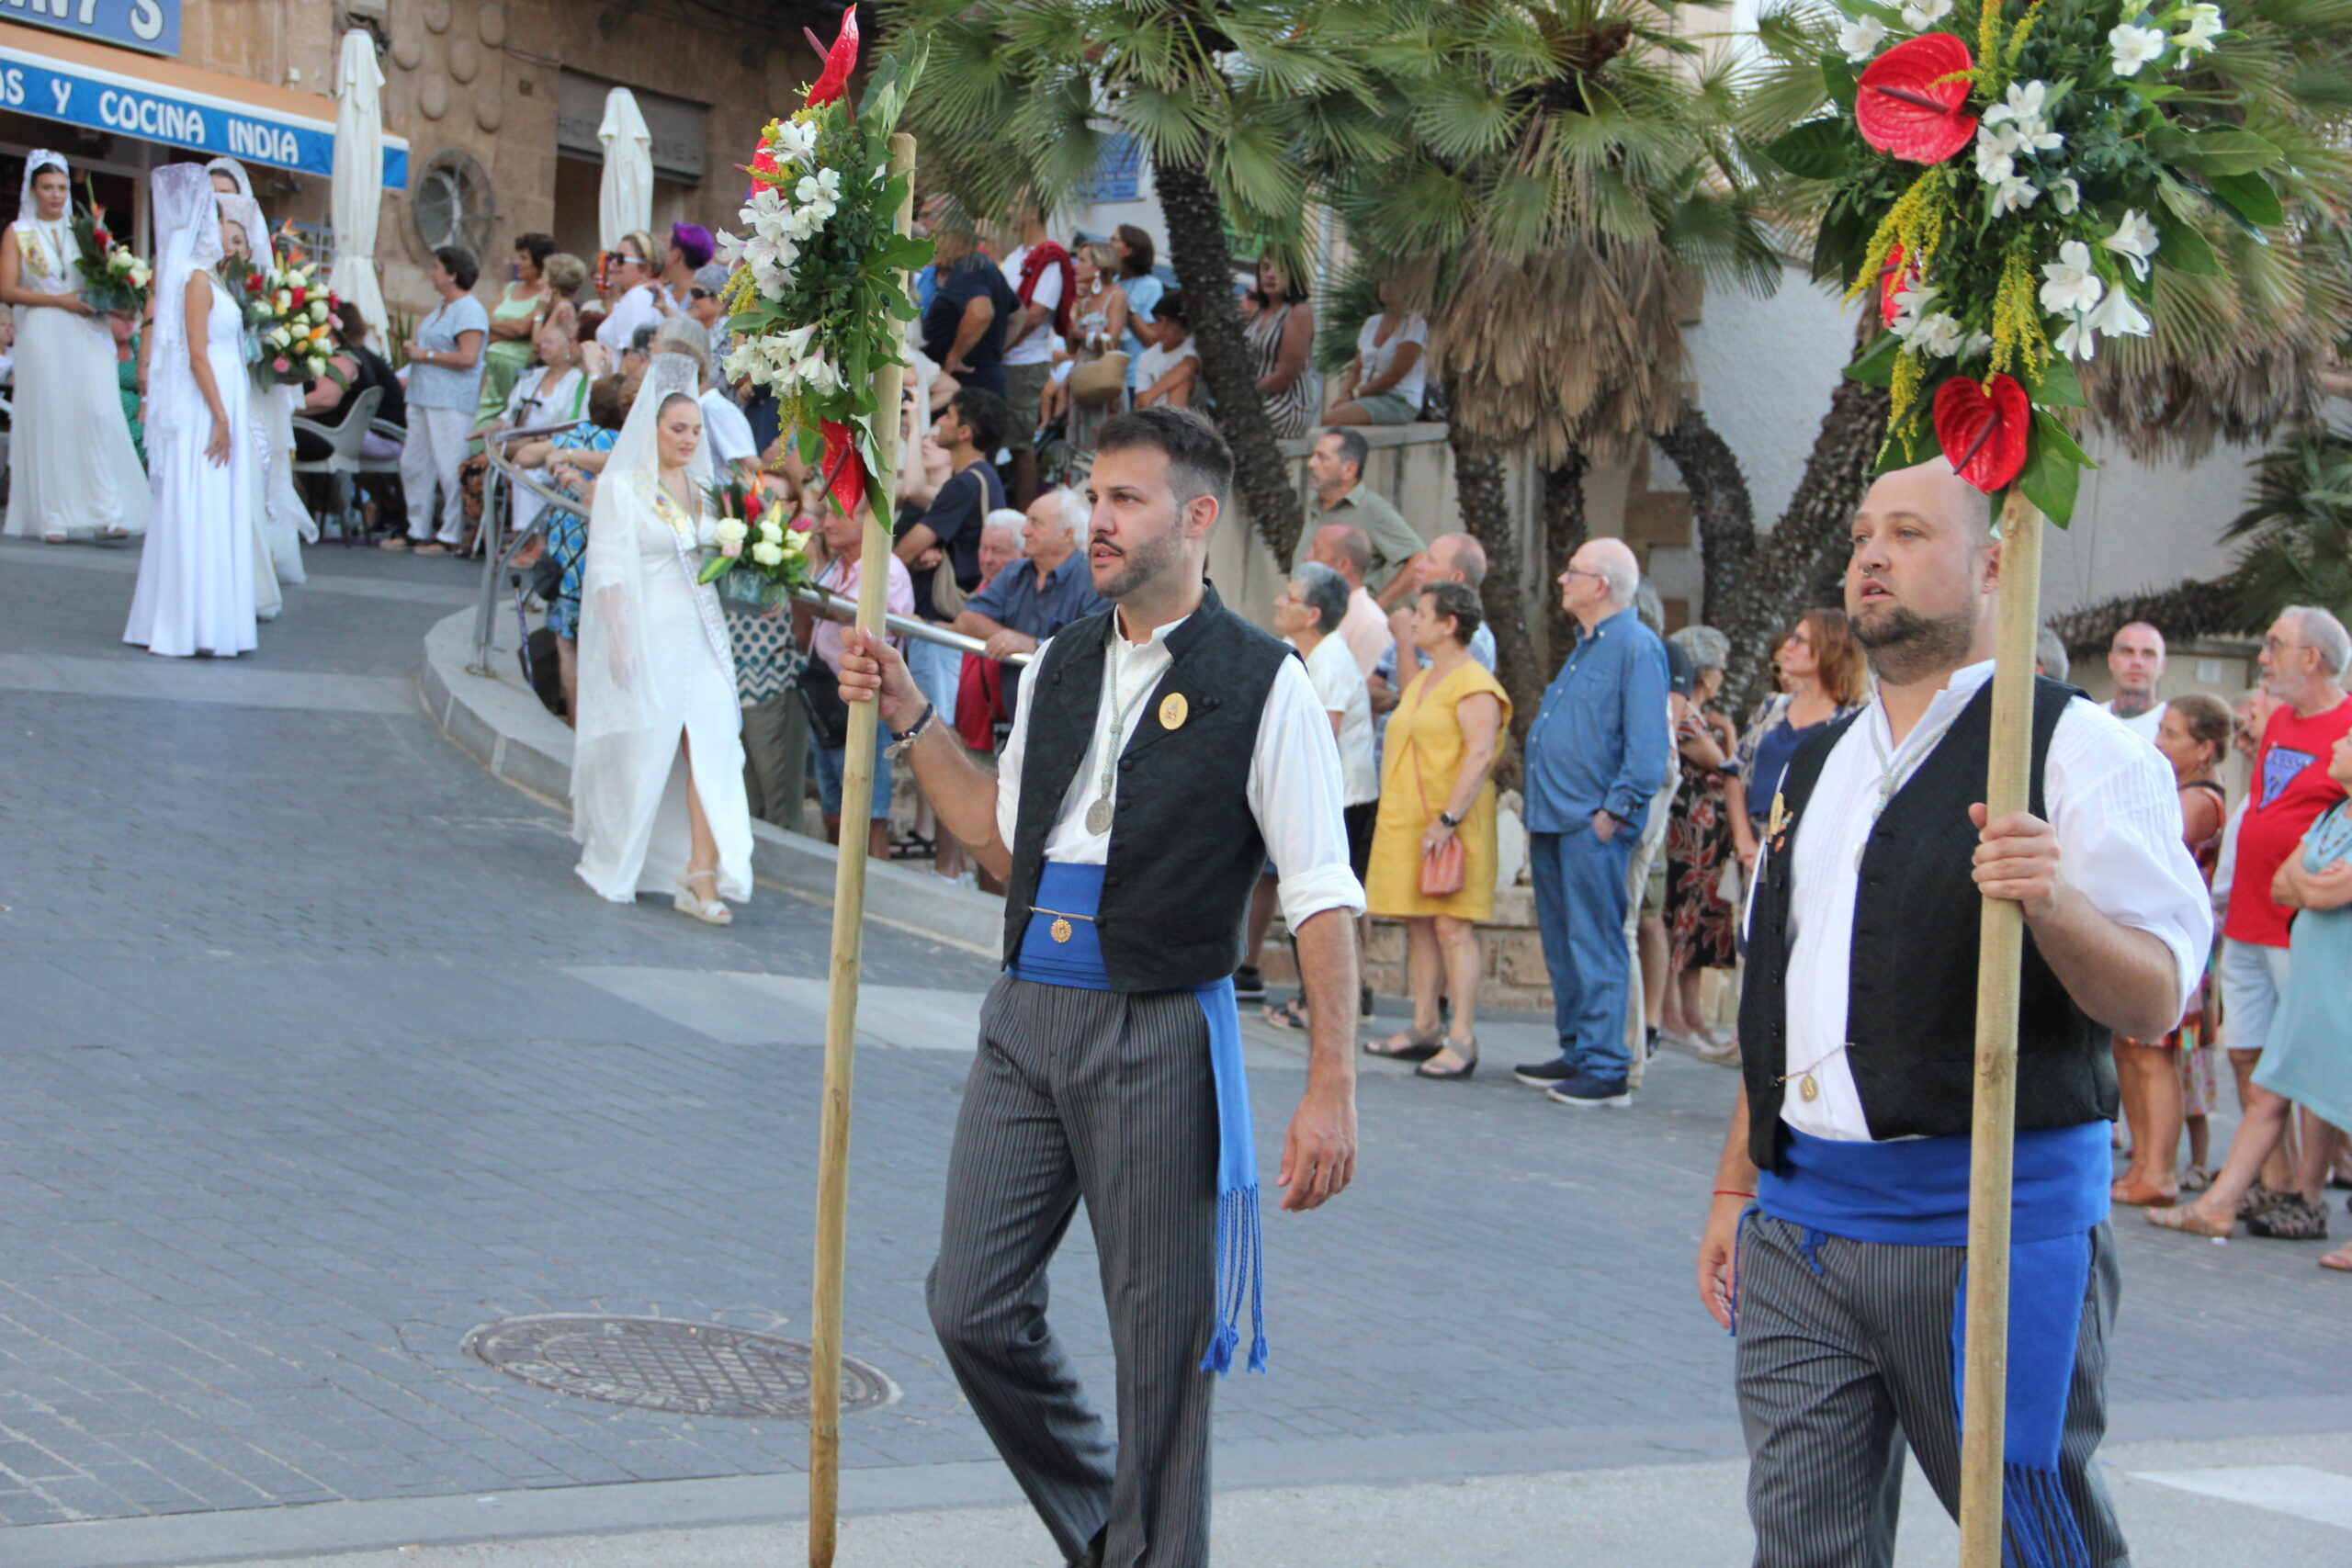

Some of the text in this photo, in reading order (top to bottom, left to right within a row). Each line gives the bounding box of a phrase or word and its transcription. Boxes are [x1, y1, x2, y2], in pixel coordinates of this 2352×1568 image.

[51, 78, 72, 115] Y
[98, 90, 205, 144] COCINA
[227, 118, 300, 164] INDIA
